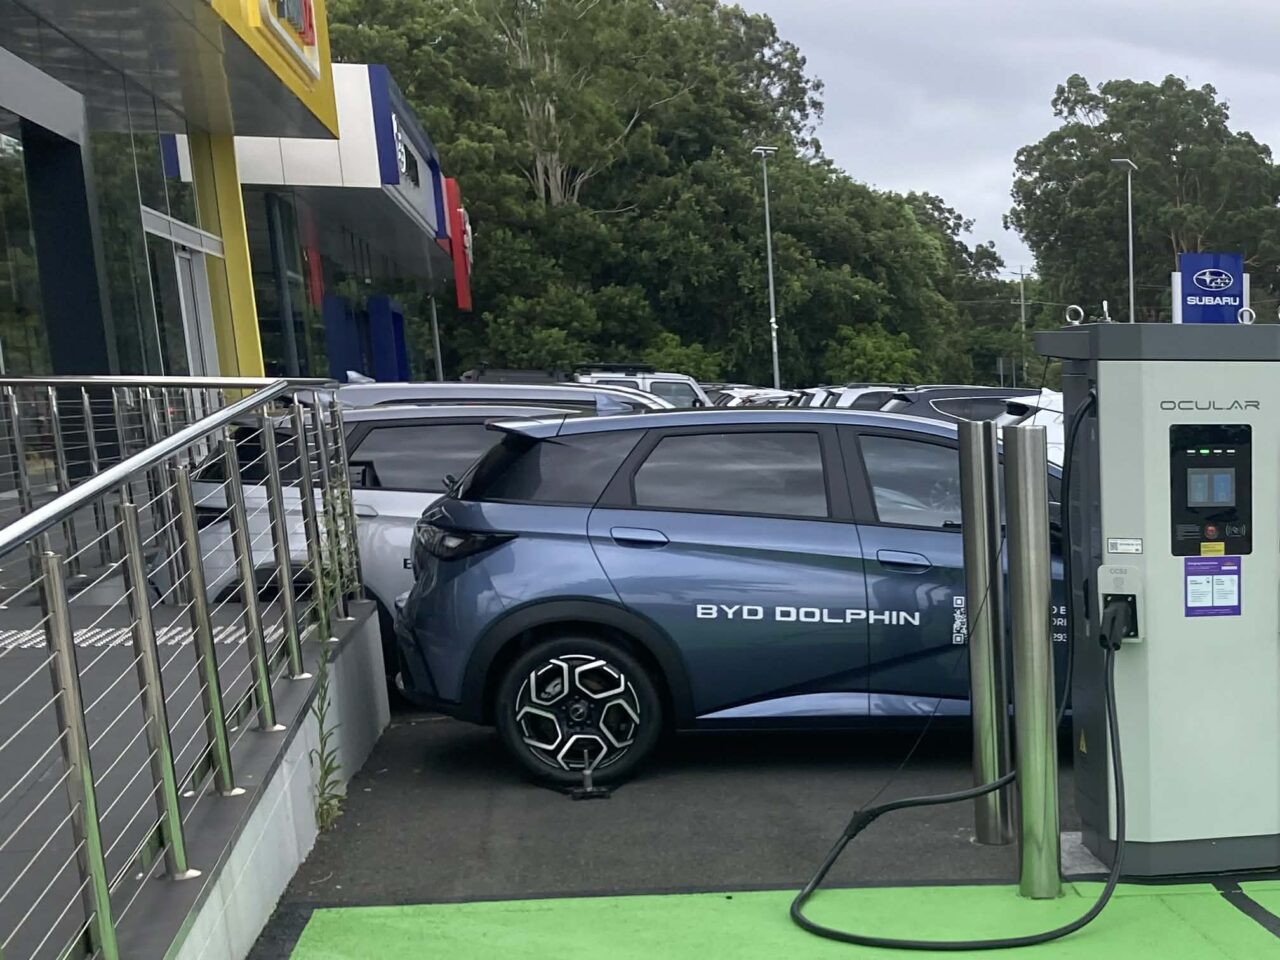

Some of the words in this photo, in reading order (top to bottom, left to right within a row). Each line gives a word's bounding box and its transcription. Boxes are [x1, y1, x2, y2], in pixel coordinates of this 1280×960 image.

[1186, 296, 1240, 306] SUBARU
[1160, 400, 1260, 411] OCULAR
[696, 604, 764, 619] BYD
[775, 606, 921, 626] DOLPHIN
